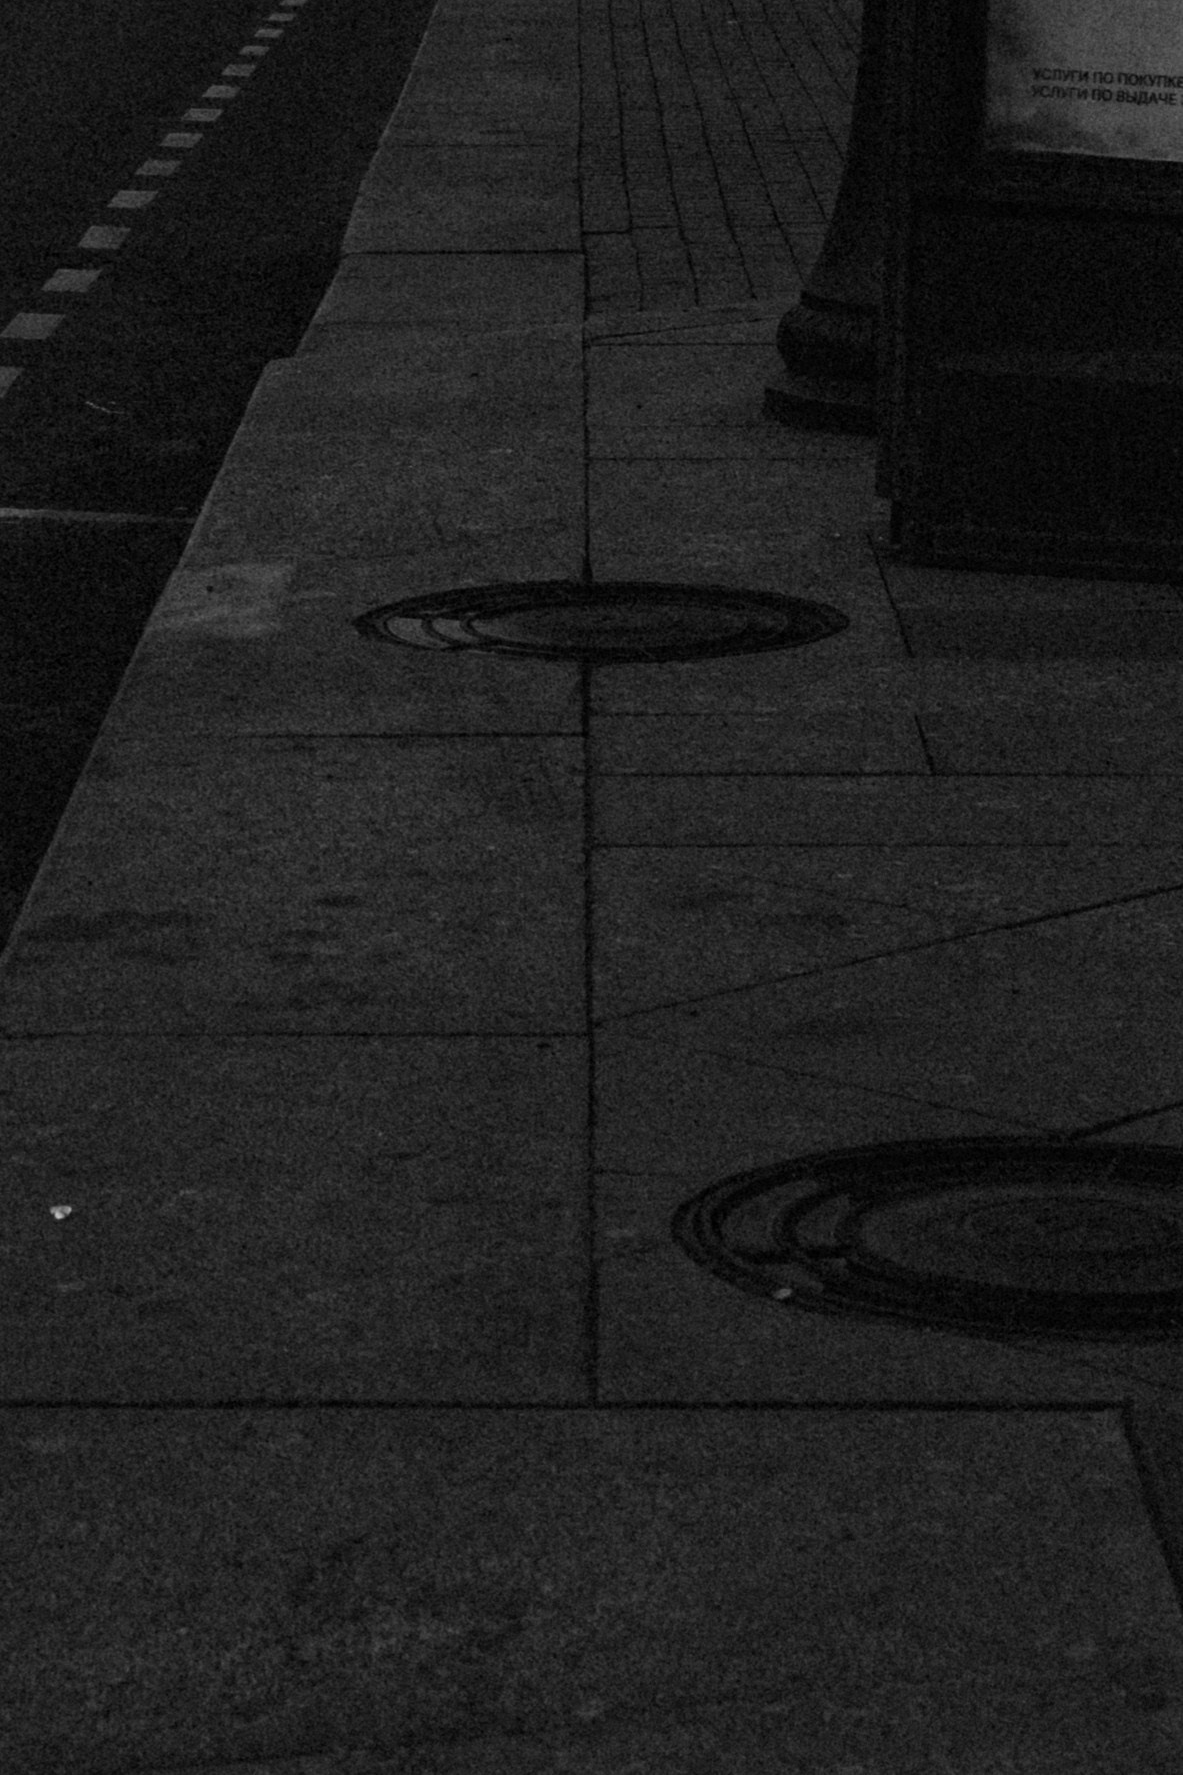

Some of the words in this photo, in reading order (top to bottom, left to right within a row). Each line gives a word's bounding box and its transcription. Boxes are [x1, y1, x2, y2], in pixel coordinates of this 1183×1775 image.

[1031, 68, 1088, 82] УСЛУГИ
[1093, 71, 1113, 84] ПО
[1030, 85, 1088, 100] УСЛУГИ
[1092, 88, 1113, 102] ПО
[1116, 90, 1177, 106] ВЫДАЧЕ
